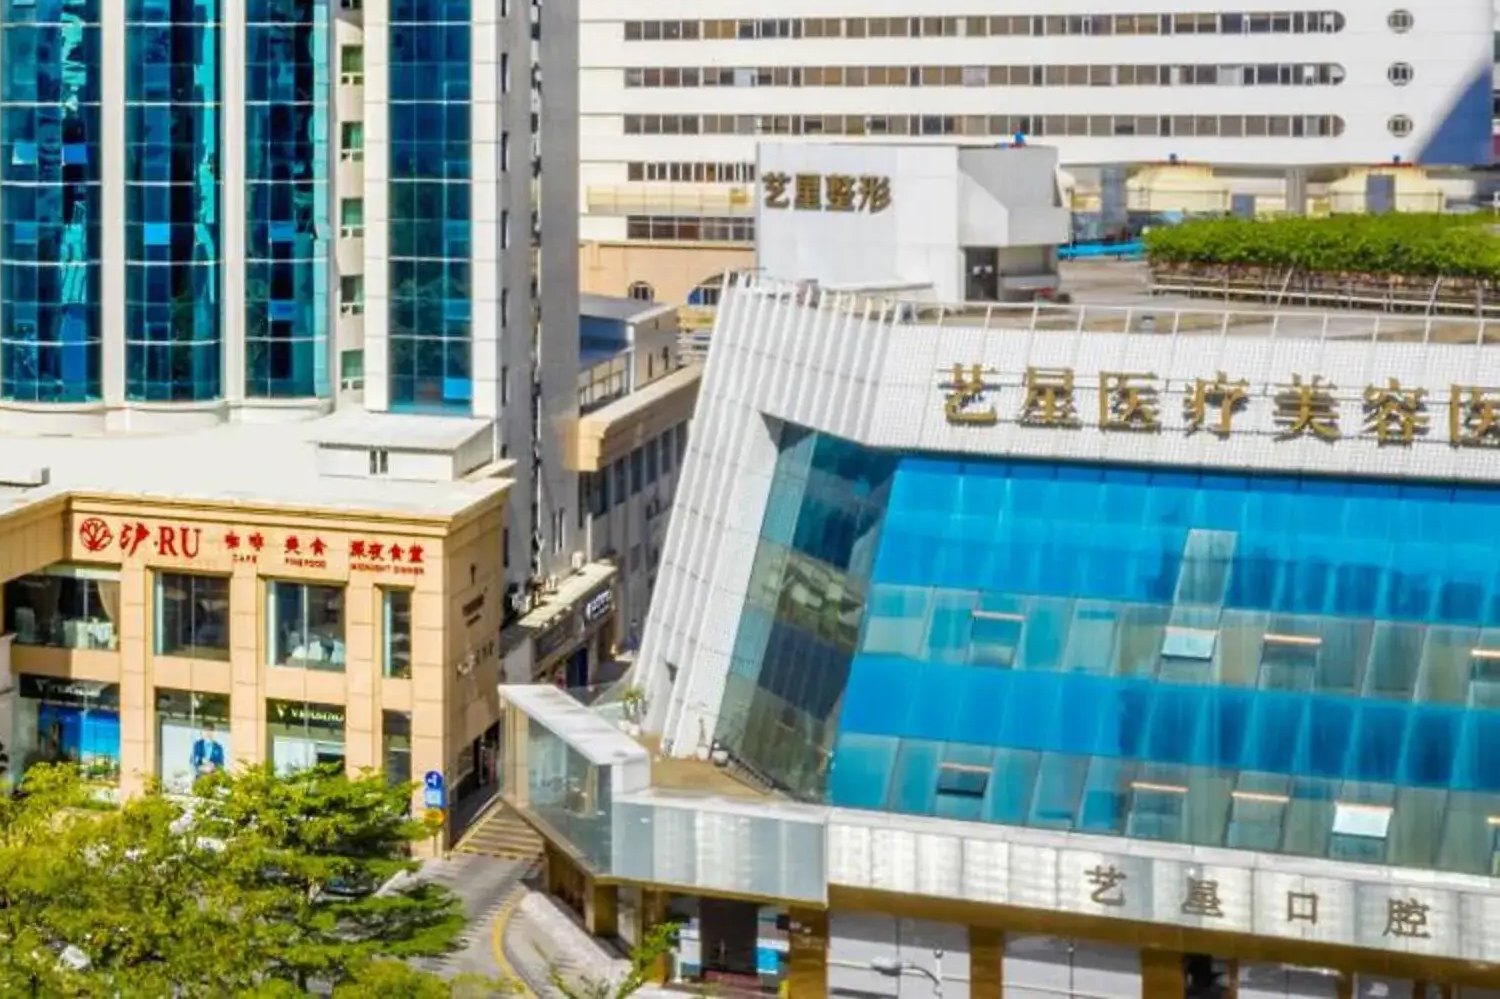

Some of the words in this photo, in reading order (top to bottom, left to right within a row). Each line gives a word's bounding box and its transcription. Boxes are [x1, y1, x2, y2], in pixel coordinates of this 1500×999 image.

[762, 171, 892, 214] 艺星整形
[284, 535, 328, 557] 美食
[1084, 864, 1432, 939] 艺星口腔
